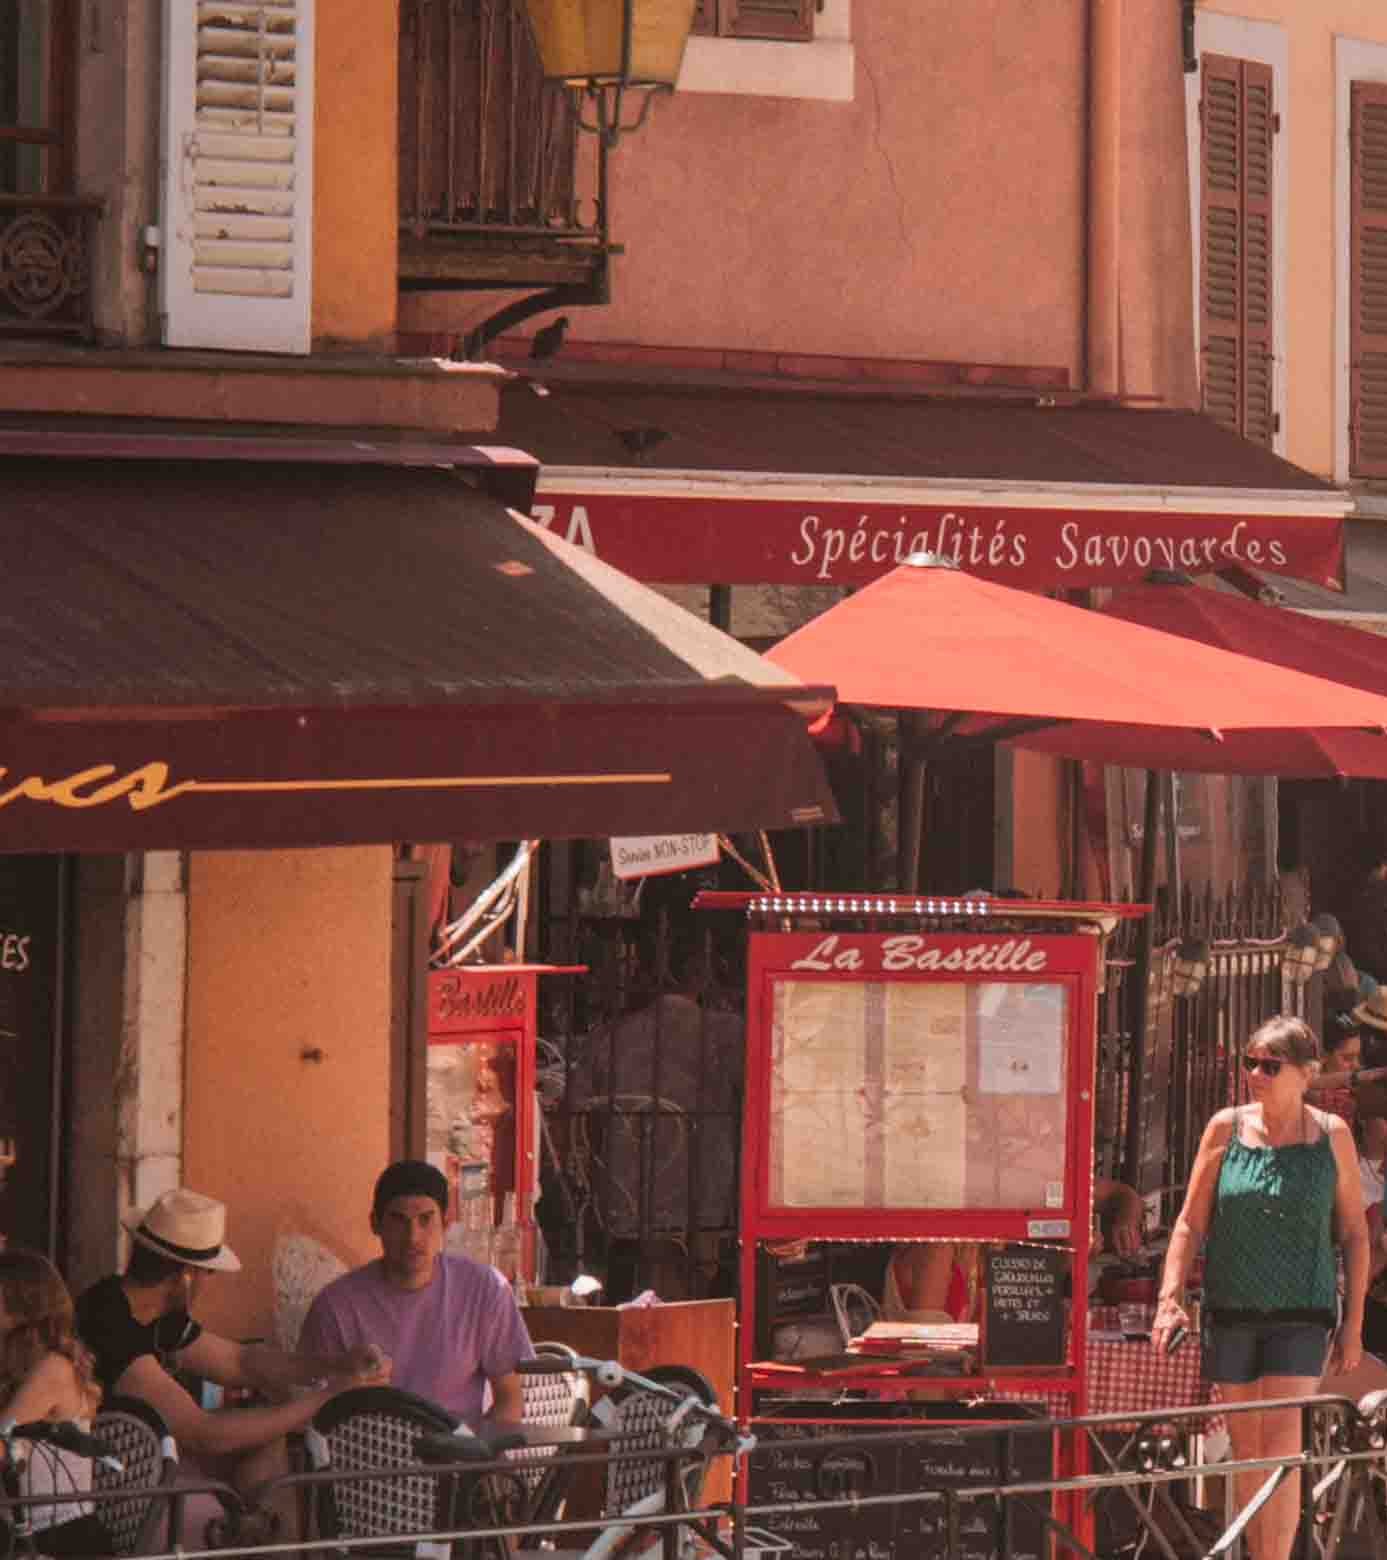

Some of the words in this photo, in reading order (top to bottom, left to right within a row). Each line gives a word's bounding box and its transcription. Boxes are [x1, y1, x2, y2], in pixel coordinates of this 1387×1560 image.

[792, 512, 1027, 578] Spécialités
[1055, 521, 1288, 571] Savoyardes
[791, 935, 864, 971] La
[881, 935, 1047, 972] Bastille
